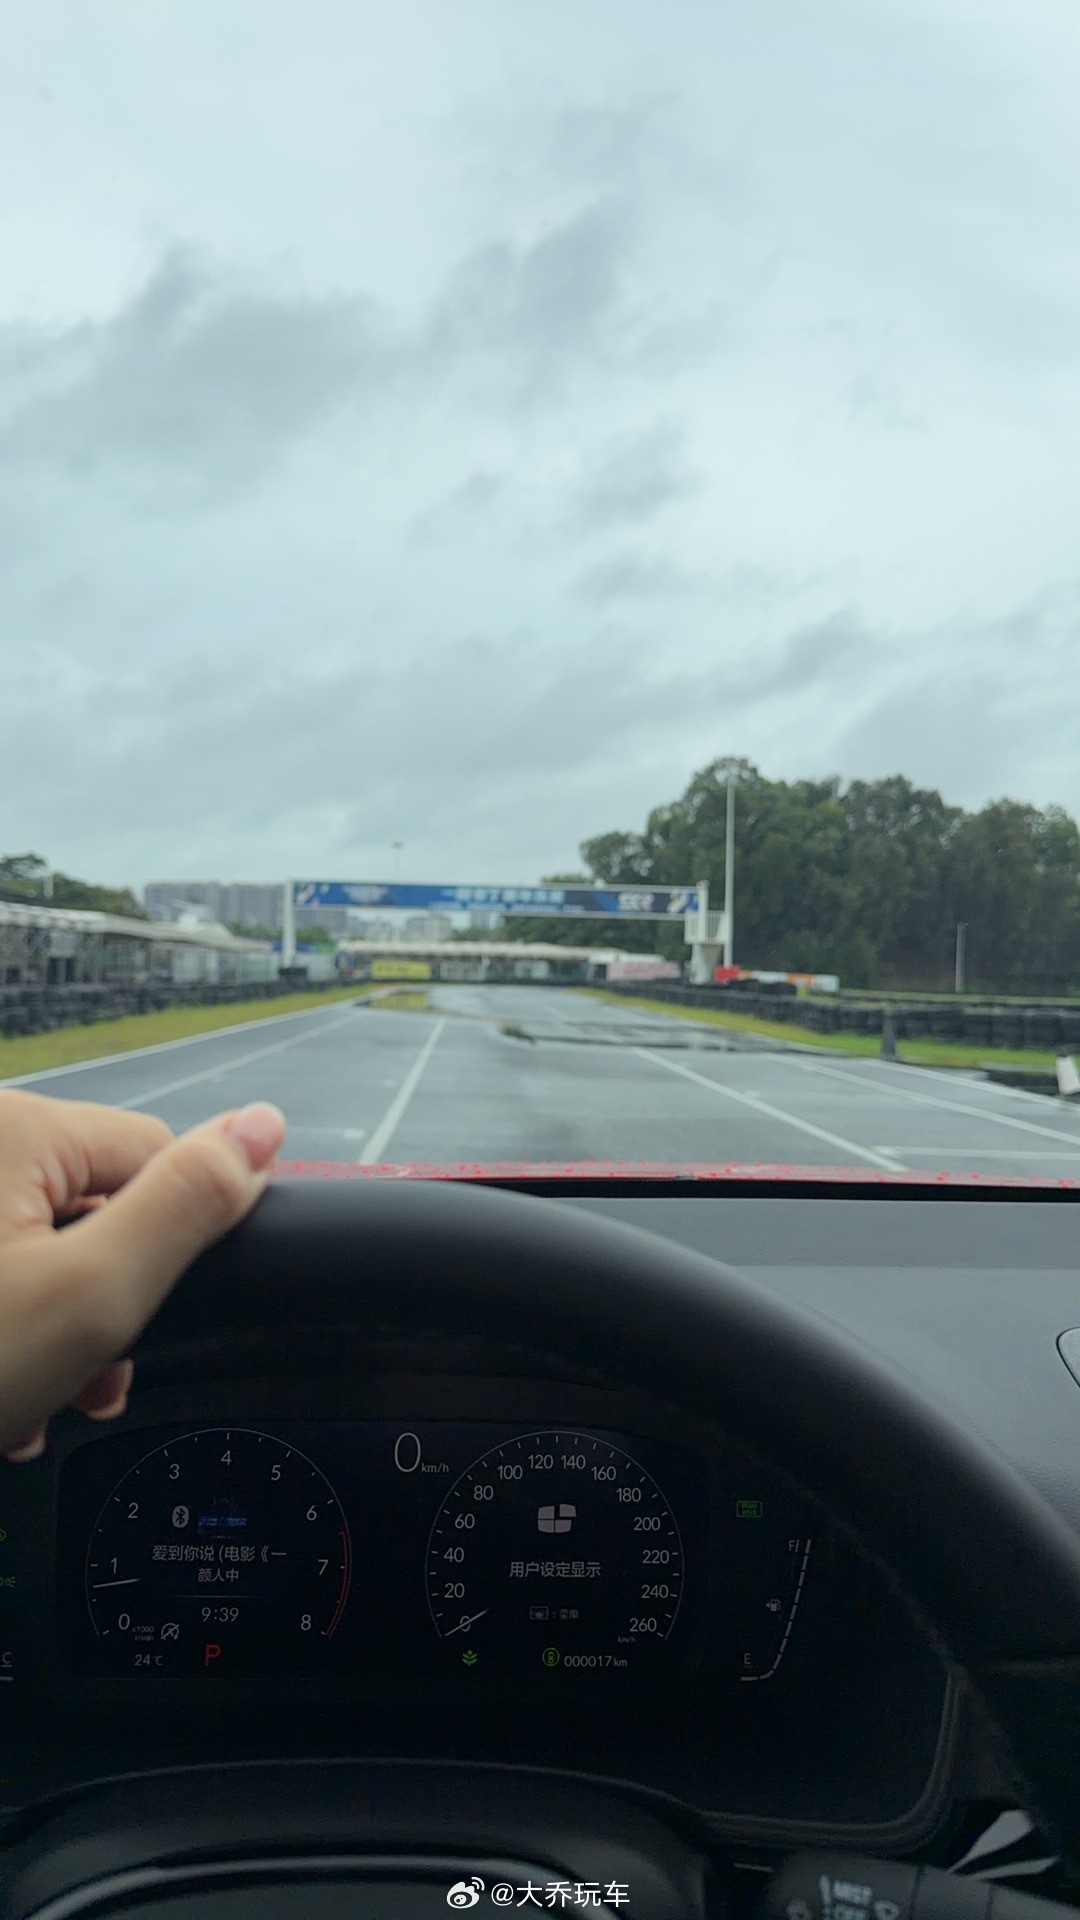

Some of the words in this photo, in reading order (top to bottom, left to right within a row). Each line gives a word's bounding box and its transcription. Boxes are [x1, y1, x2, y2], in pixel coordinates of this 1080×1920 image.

[220, 1450, 232, 1466] 4
[394, 1431, 422, 1474] 0
[421, 1462, 450, 1474] km/h
[528, 1454, 554, 1470] 120
[560, 1454, 587, 1470] 140
[169, 1463, 180, 1480] 3
[270, 1464, 282, 1481] 5
[497, 1465, 523, 1481] 100
[591, 1466, 617, 1481] 160
[473, 1485, 494, 1501] 80
[616, 1486, 642, 1503] 180
[127, 1502, 139, 1519] 2
[306, 1504, 318, 1521] 6
[454, 1513, 476, 1529] 60
[633, 1516, 661, 1532] 200
[443, 1547, 465, 1563] 40
[642, 1549, 670, 1565] 220
[110, 1557, 118, 1574] 1
[318, 1559, 329, 1575] 7
[509, 1561, 602, 1578] 用户设定显示
[197, 1568, 240, 1582] 颜人中
[444, 1582, 465, 1599] 20
[641, 1584, 669, 1599] 240
[118, 1613, 131, 1631] 0
[201, 1607, 239, 1623] 9:39
[300, 1614, 312, 1631] 8
[629, 1617, 657, 1633] 260
[204, 1643, 222, 1667] P
[564, 1654, 613, 1668] 000017
[613, 1657, 628, 1668] km
[743, 1653, 751, 1666] E
